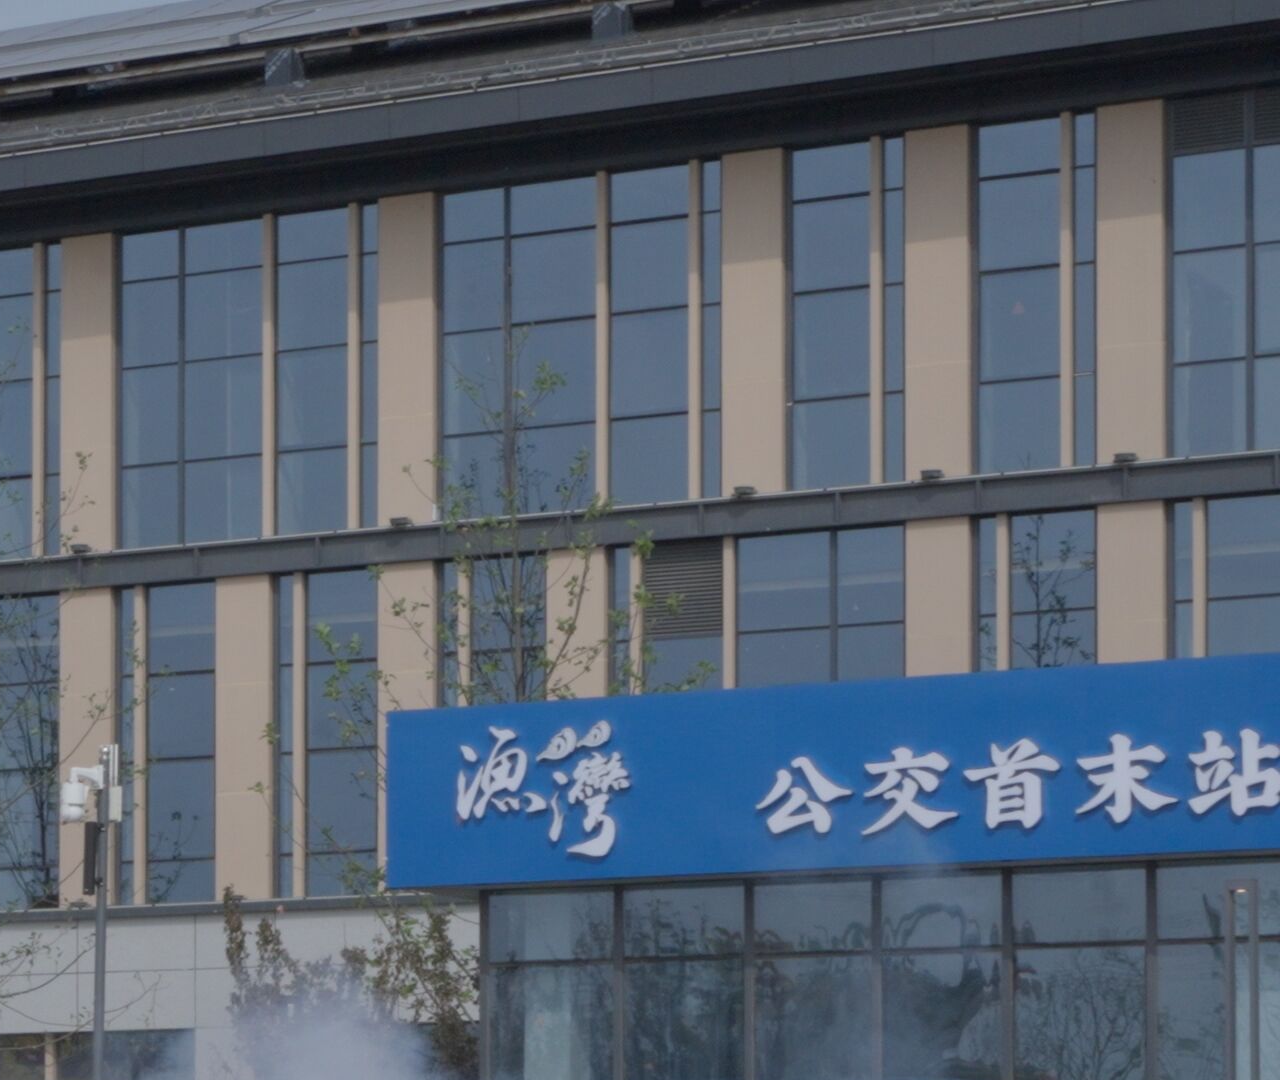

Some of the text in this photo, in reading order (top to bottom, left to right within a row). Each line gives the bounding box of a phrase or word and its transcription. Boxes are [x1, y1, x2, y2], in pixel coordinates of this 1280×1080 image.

[756, 729, 1280, 837] 公交首末站
